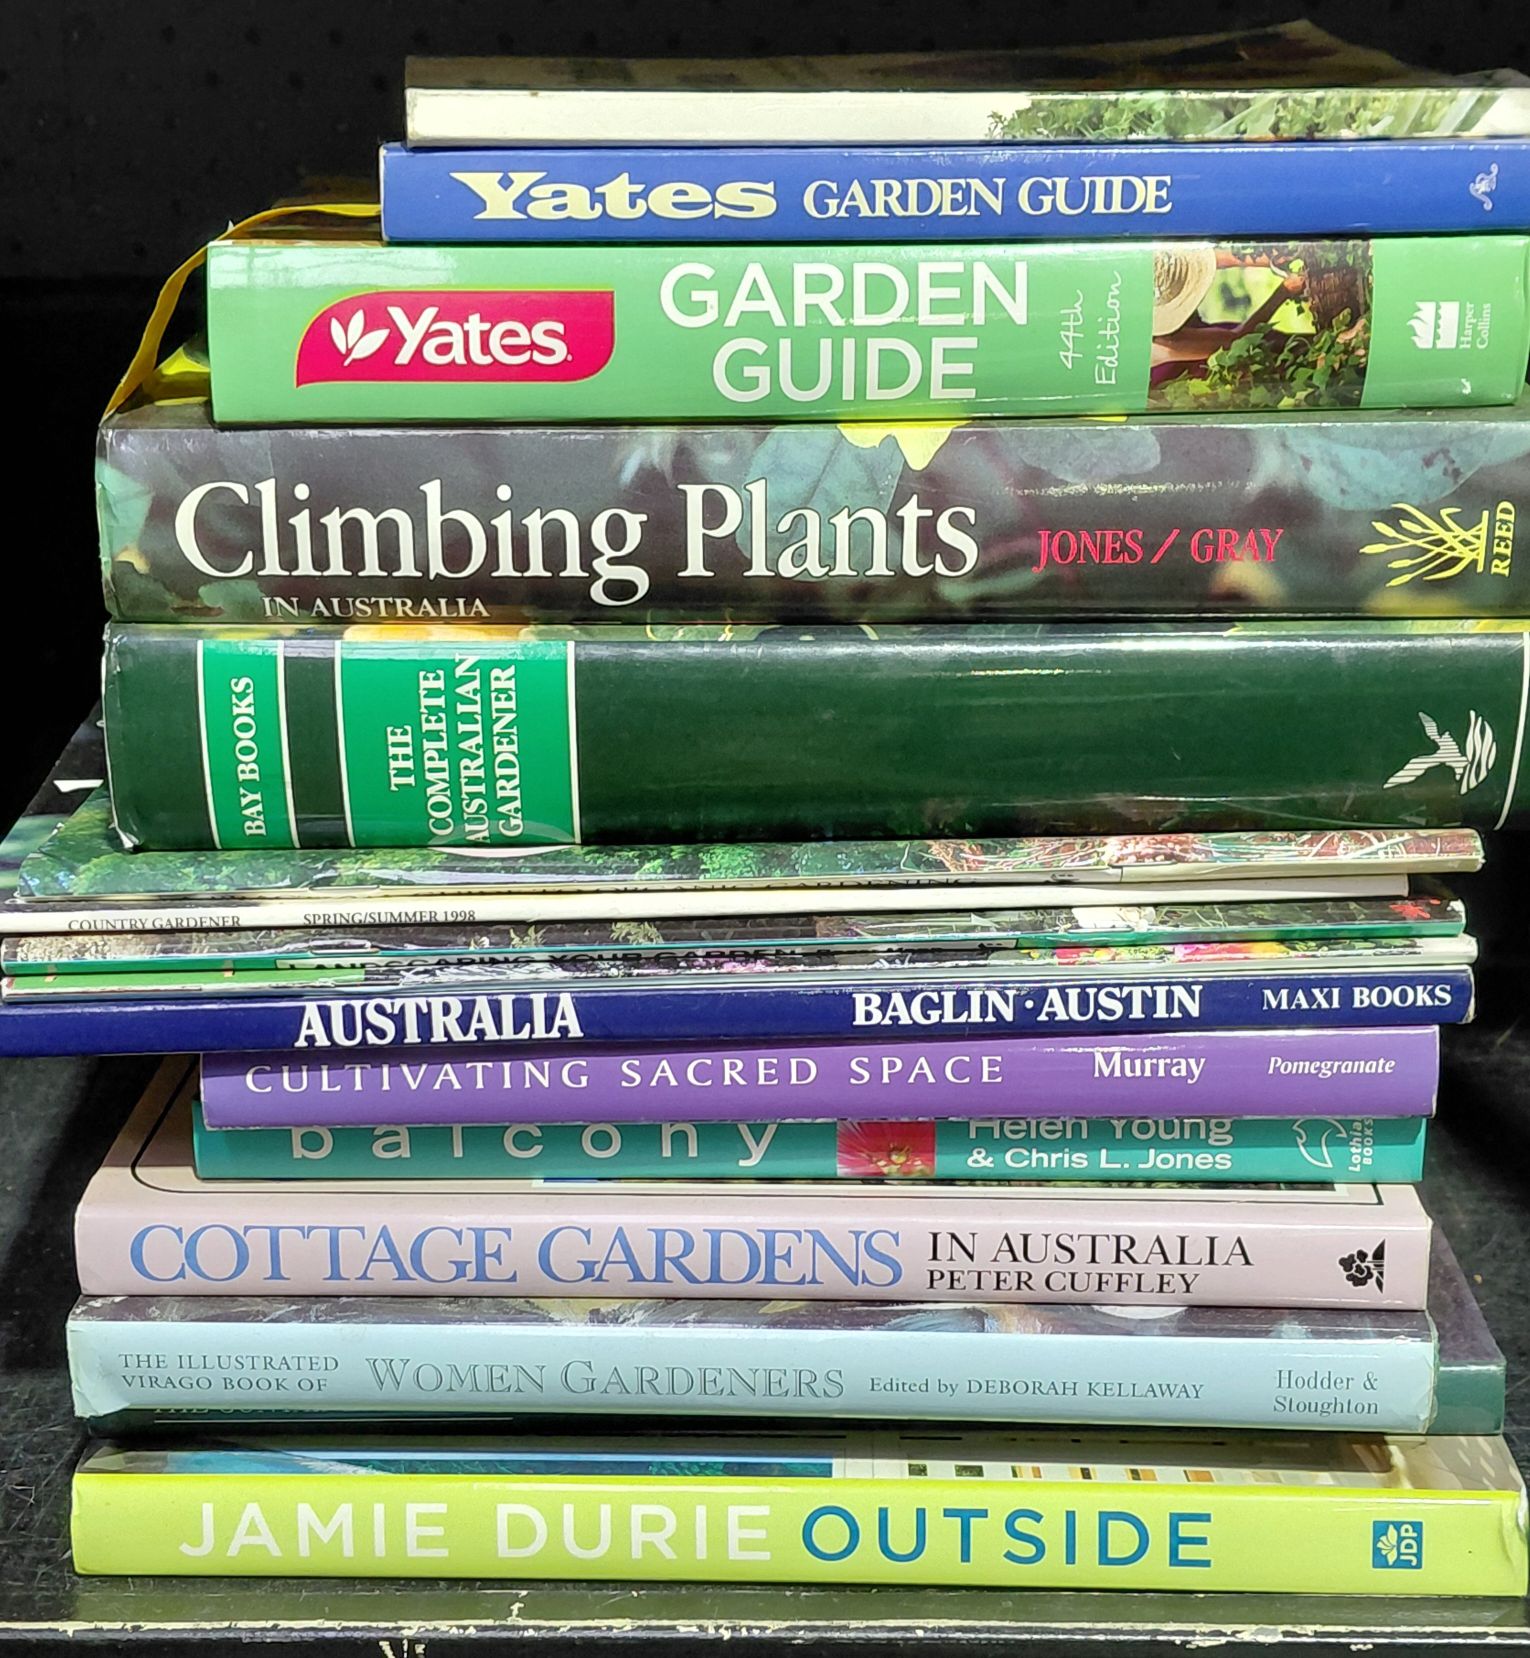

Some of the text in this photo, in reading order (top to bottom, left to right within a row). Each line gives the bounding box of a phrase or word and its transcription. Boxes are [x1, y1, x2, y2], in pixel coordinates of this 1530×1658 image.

[450, 171, 1173, 220] Yates GARDEN GUIDE
[660, 260, 1028, 328] GARDEN
[386, 305, 570, 365] Yates
[1059, 289, 1084, 369] 44th
[1095, 270, 1121, 384] Edition
[1459, 301, 1476, 349] Harper
[1476, 302, 1491, 349] Collins
[712, 336, 978, 403] GUIDE
[174, 478, 978, 607] Climbing Plants
[1032, 529, 1144, 573] JONES
[1191, 528, 1285, 564] GRAY
[1491, 501, 1515, 577] REED
[262, 597, 489, 618] IN AUSTRALIA
[230, 676, 267, 838] BAY BOOKS
[386, 725, 415, 791] THE
[418, 669, 454, 836] COMPLETE
[454, 652, 490, 844] AUSTRALIAN
[490, 665, 523, 837] GARDENER
[68, 910, 476, 931] COUNTRY GARDENER SPRING/SUMMER 1998
[294, 992, 584, 1049] AUSTRALIA
[1263, 987, 1340, 1010] MAXI
[1354, 984, 1452, 1008] BOOKS
[245, 1050, 1396, 1093] CULTIVATING SACRED SPACE Murray Pomegranate
[966, 1148, 1232, 1170] & Chris L. Jones
[1348, 1118, 1363, 1172] Lothia
[130, 1223, 1254, 1288] COTTAGE GARDENS IN AUSTRALIA
[927, 1269, 1201, 1295] PETER CUFFLEY
[119, 1353, 339, 1372] THE ILLUSTRATED
[122, 1374, 328, 1392] VIRAGO BOOK OF
[365, 1357, 844, 1399] WOMEN GARDENERS
[870, 1376, 1205, 1399] Edited by DEBORAH KELLAWAY
[1272, 1369, 1379, 1391] Hodder &
[1272, 1396, 1379, 1417] Stoughton
[178, 1502, 1213, 1568] JAMIE DURIE OUTSIDE
[1400, 1524, 1417, 1566] JDP
